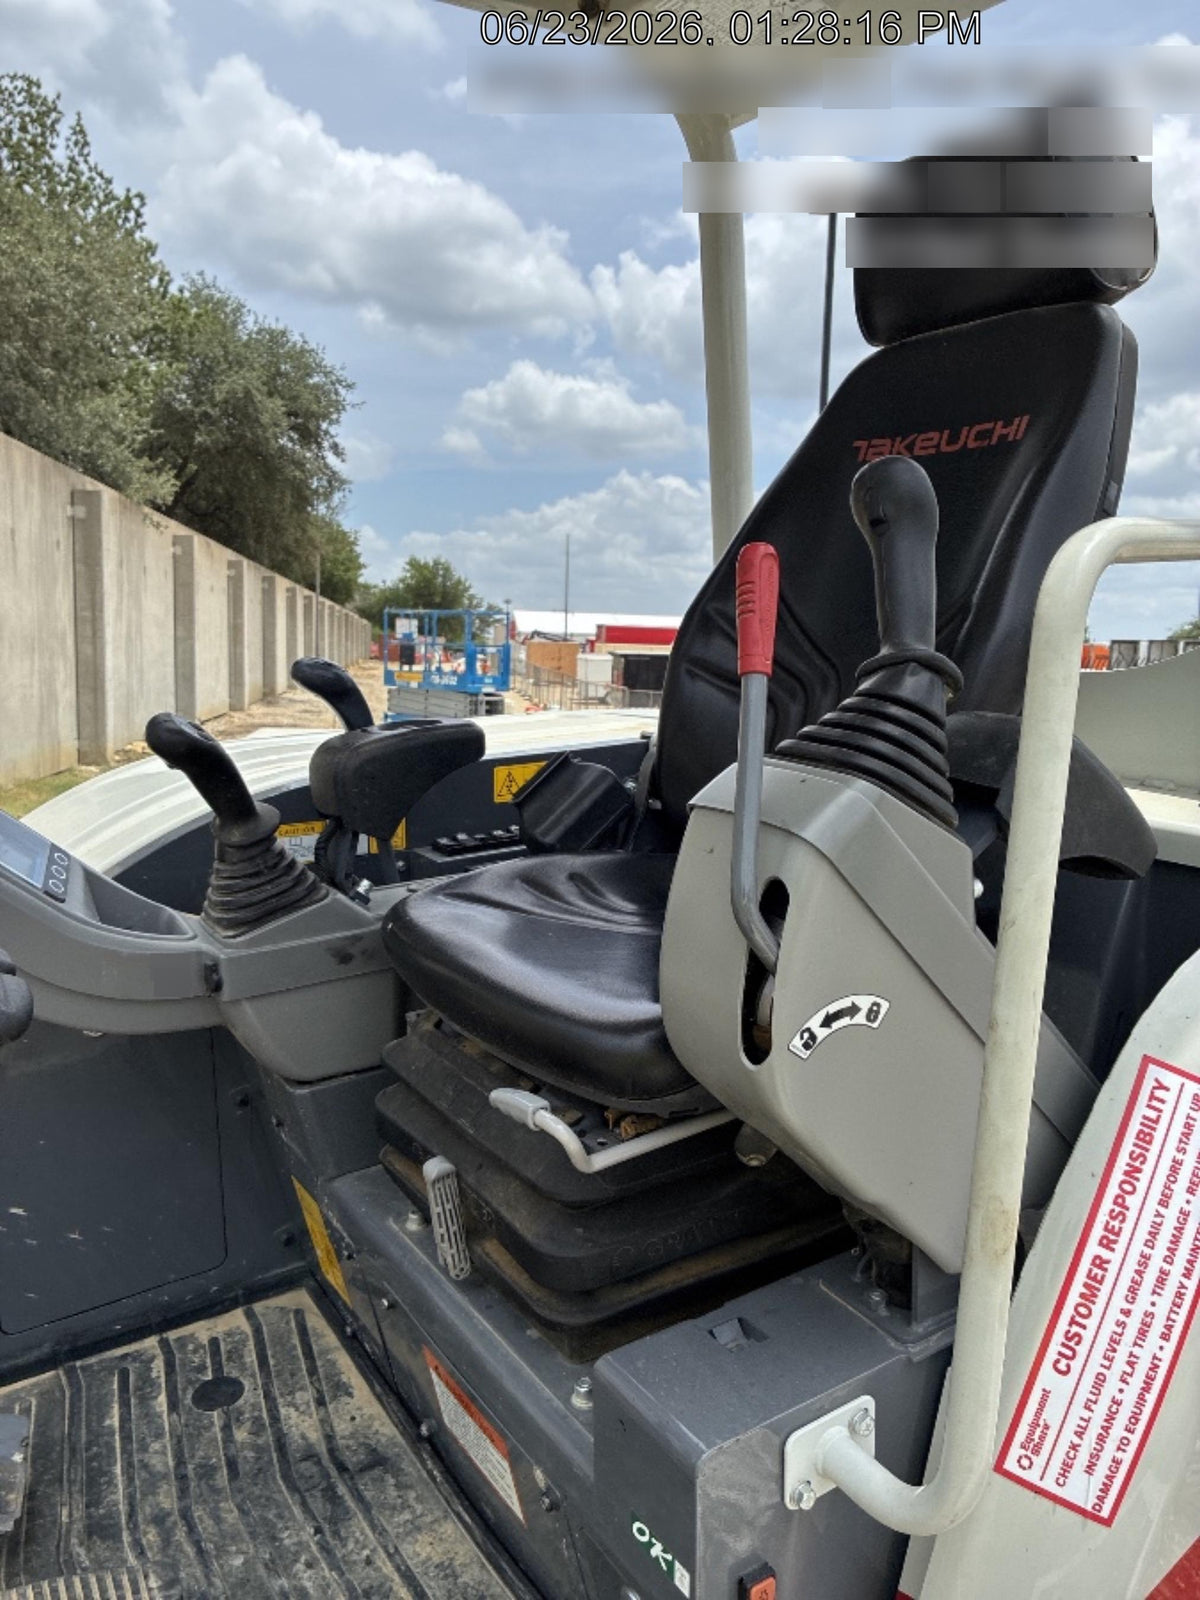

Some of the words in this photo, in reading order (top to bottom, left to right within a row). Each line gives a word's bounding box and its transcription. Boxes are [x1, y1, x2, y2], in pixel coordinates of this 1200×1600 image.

[852, 414, 1030, 462] TAKEUCHI
[278, 825, 316, 837] CAUTON
[1176, 1113, 1196, 1155] START
[1158, 1156, 1183, 1209] BEFORE
[1053, 1255, 1111, 1376] CUSTOMER
[1098, 1078, 1170, 1252] RESPONSIBILITY
[1144, 1209, 1165, 1250] DAILY
[1125, 1250, 1151, 1305] GREASE
[1120, 1308, 1132, 1318] &
[1084, 1396, 1122, 1476] INSURANCE
[1119, 1351, 1140, 1385] FLAT
[1133, 1310, 1155, 1348] TIRES
[1151, 1267, 1170, 1296] TIRE
[1163, 1207, 1190, 1266] DAMAGE
[1100, 1319, 1126, 1370] LEVELS
[1084, 1372, 1106, 1413] FLUID
[1092, 1456, 1123, 1513] DAMAGE
[1116, 1436, 1131, 1453] TO
[1124, 1353, 1162, 1434] EQUIPMENT
[1159, 1281, 1188, 1342] BATTERY
[1020, 1388, 1051, 1452] Equipment
[1074, 1417, 1091, 1440] ALL
[1055, 1440, 1081, 1487] CHECK
